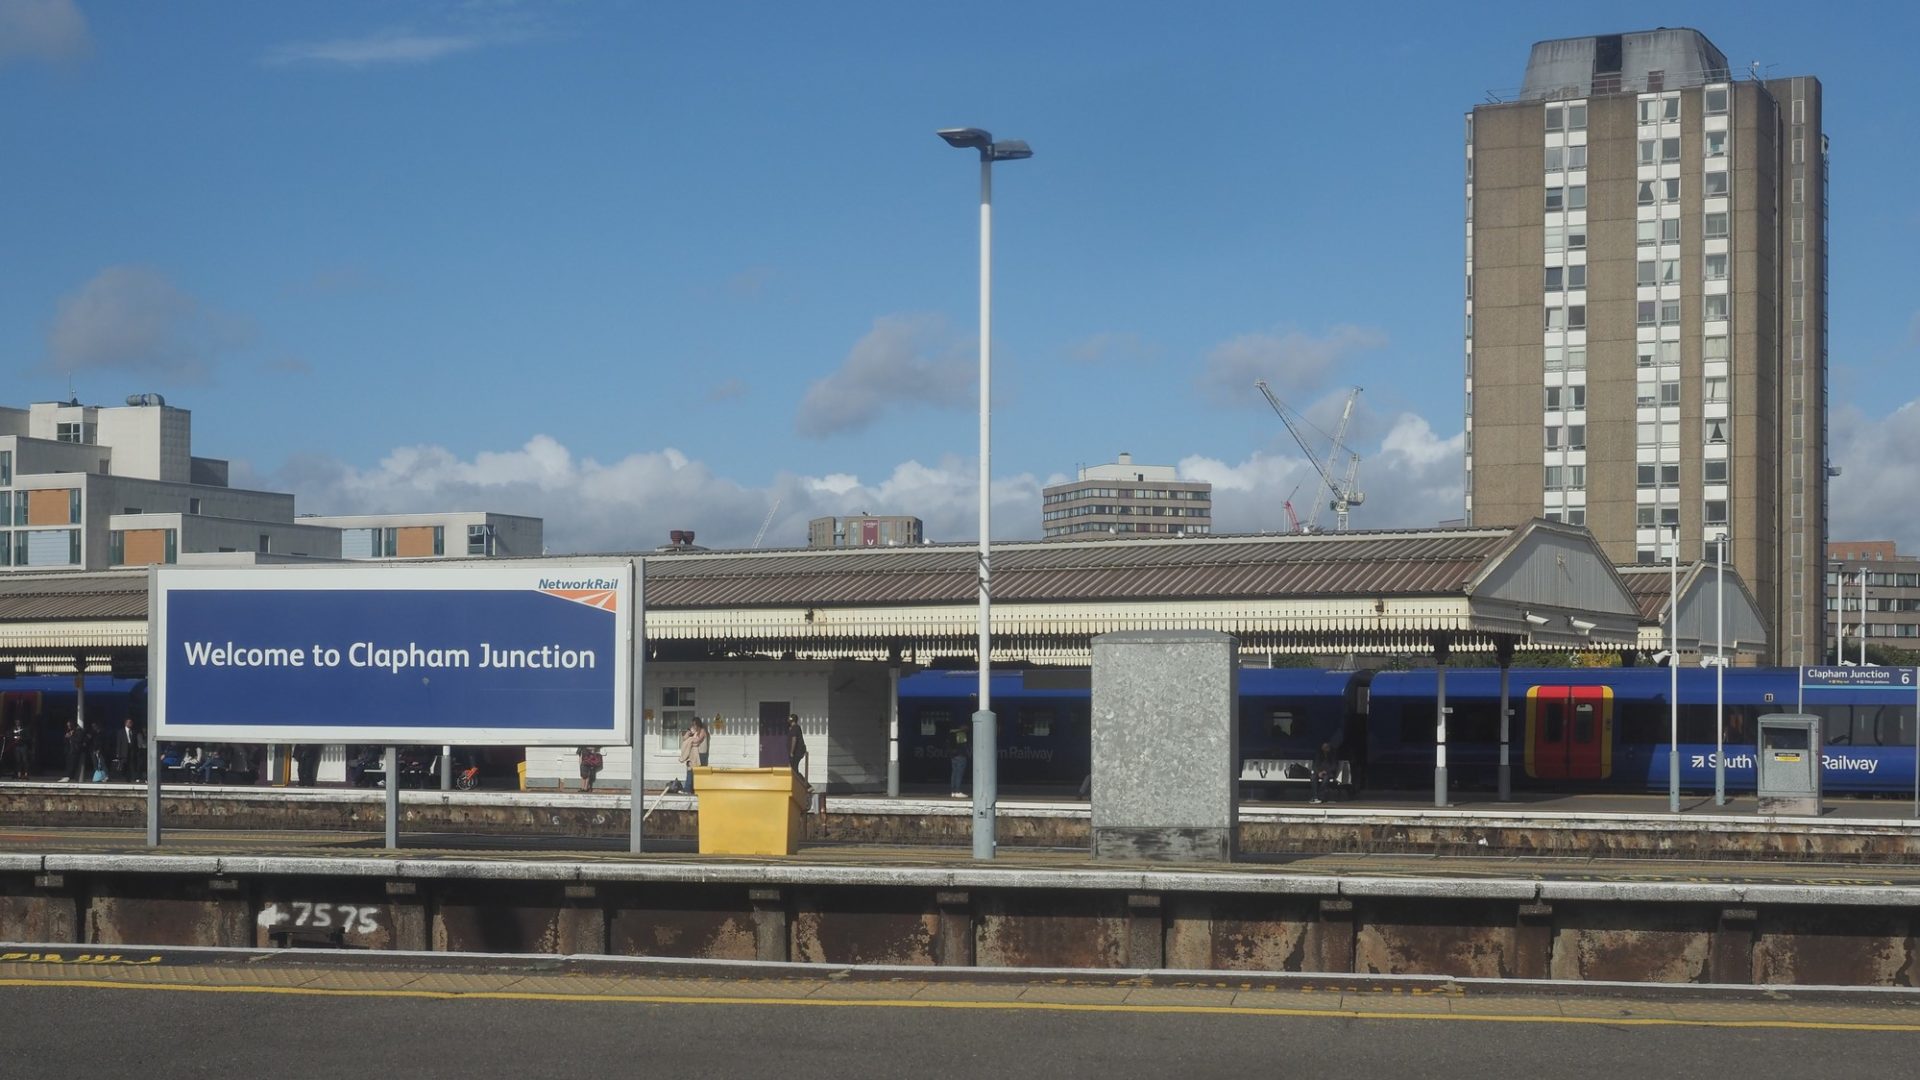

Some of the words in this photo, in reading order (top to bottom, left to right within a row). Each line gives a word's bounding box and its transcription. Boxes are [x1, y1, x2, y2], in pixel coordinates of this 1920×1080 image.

[538, 578, 618, 589] NetworkRail
[184, 641, 304, 667] Welcome
[312, 644, 341, 667] to
[348, 642, 470, 674] Clapham
[479, 643, 595, 669] Junction
[1807, 669, 1848, 679] Clapham
[1849, 669, 1890, 679] Junction
[1901, 673, 1910, 684] 6
[1009, 745, 1054, 762] Railway
[1821, 755, 1878, 774] Railway
